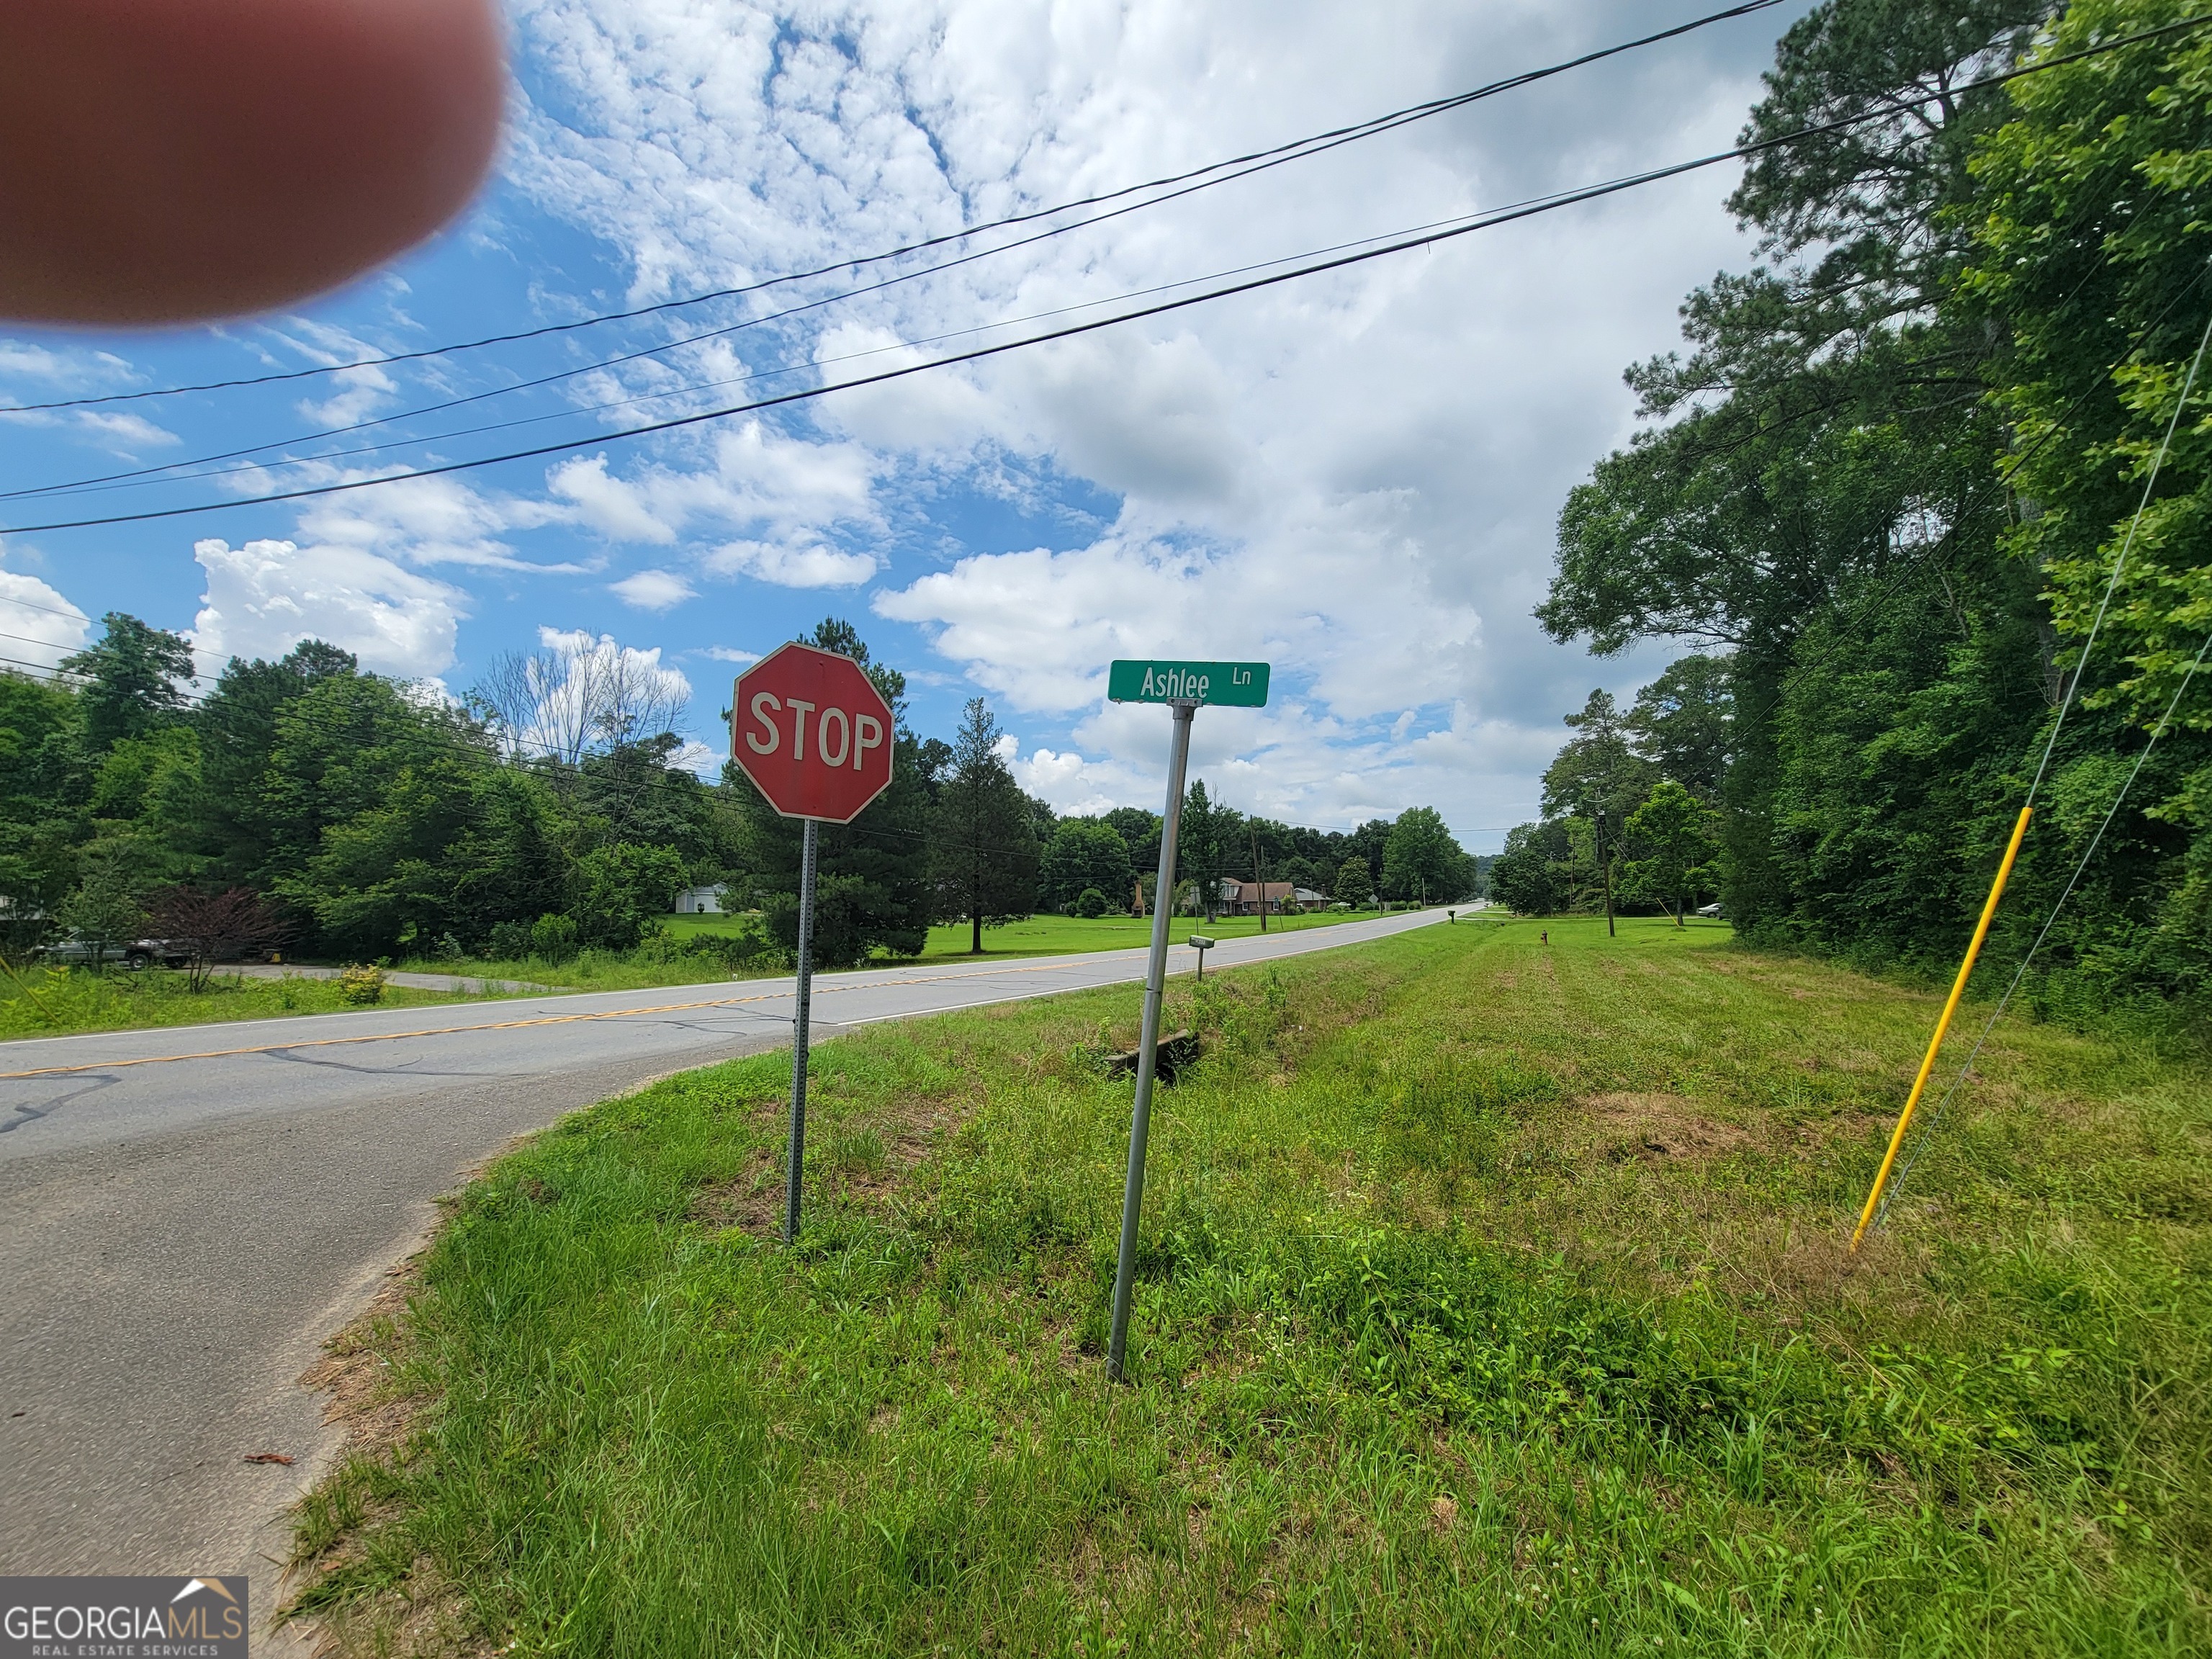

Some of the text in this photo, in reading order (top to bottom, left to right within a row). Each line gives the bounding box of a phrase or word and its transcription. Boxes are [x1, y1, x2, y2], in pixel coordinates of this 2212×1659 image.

[1140, 667, 1251, 698] Ashlee Ln
[746, 691, 884, 771] STOP
